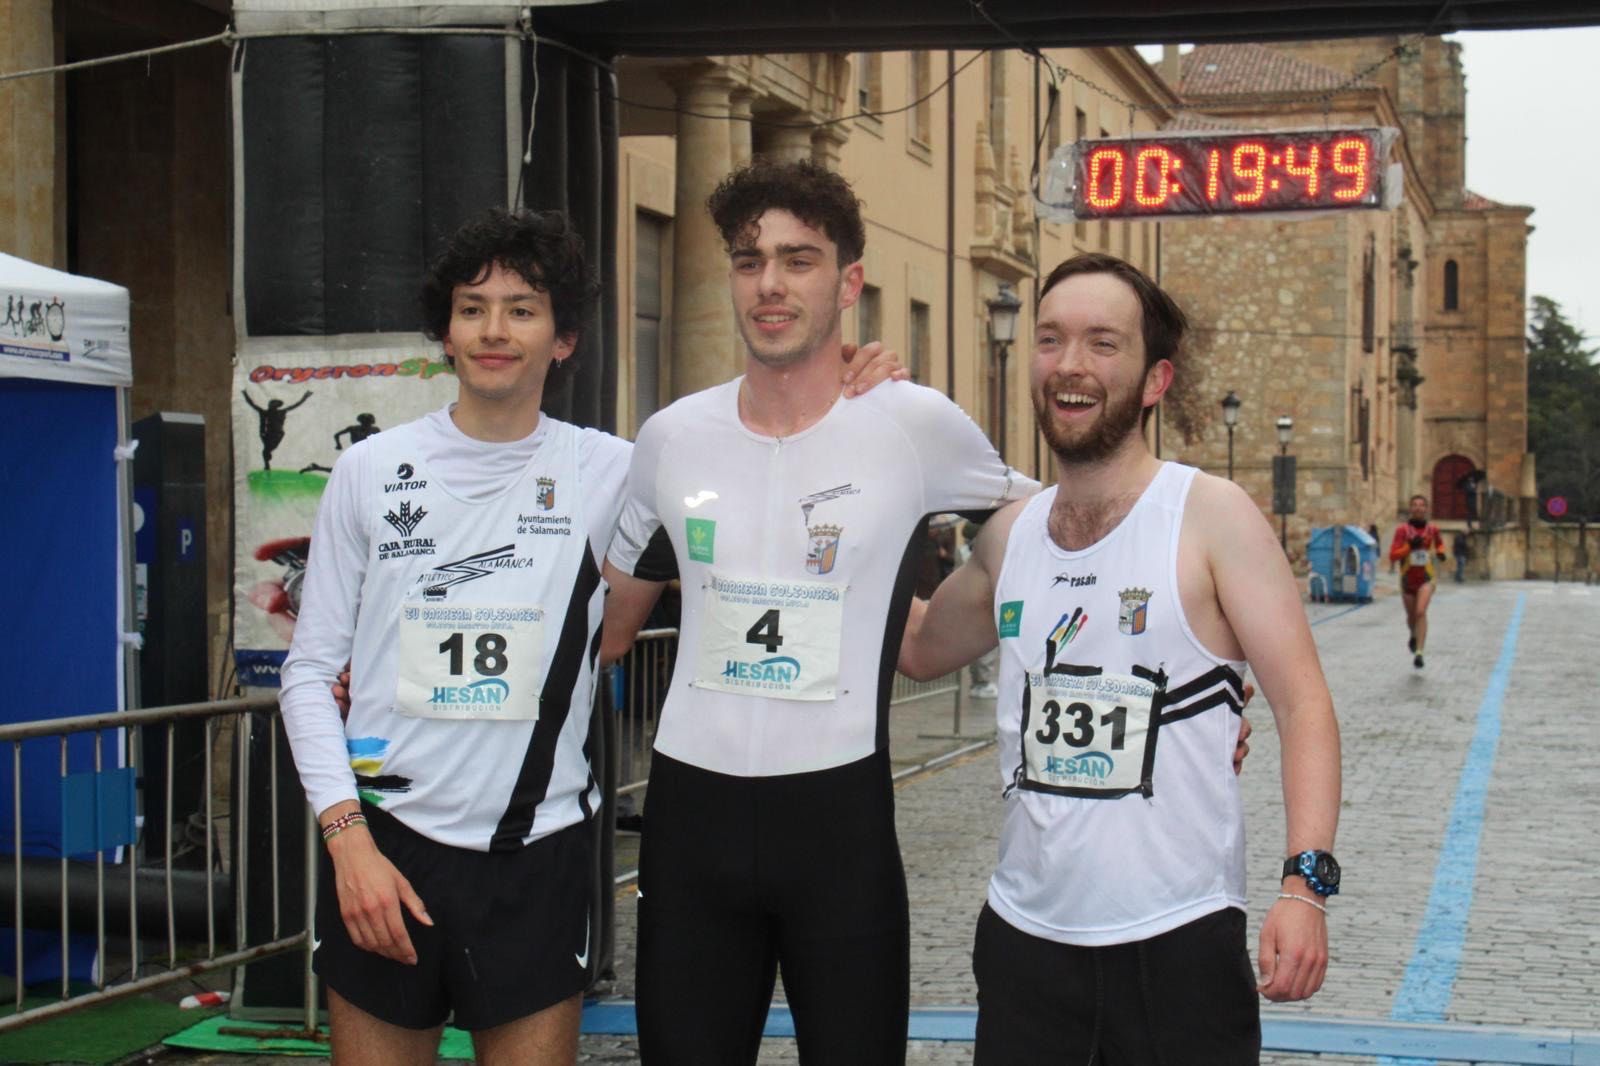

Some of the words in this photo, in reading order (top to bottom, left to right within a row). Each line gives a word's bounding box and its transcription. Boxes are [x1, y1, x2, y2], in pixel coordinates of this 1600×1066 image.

[1088, 140, 1367, 207] 00:19:49
[384, 480, 427, 493] VIATOR
[517, 513, 572, 525] Ayuntamiento
[517, 527, 527, 535] de
[529, 525, 571, 536] Salamanca
[379, 541, 400, 552] CAJA
[403, 538, 436, 549] RURAL
[379, 552, 390, 561] DE
[391, 548, 436, 559] SALAMANCA
[422, 607, 472, 621] CARRERA
[474, 607, 541, 622] SOLIDARIA
[746, 609, 784, 653] 4
[439, 632, 509, 677] 18
[723, 660, 792, 683] HESAN
[431, 686, 501, 705] HESAN
[1035, 699, 1128, 750] 331
